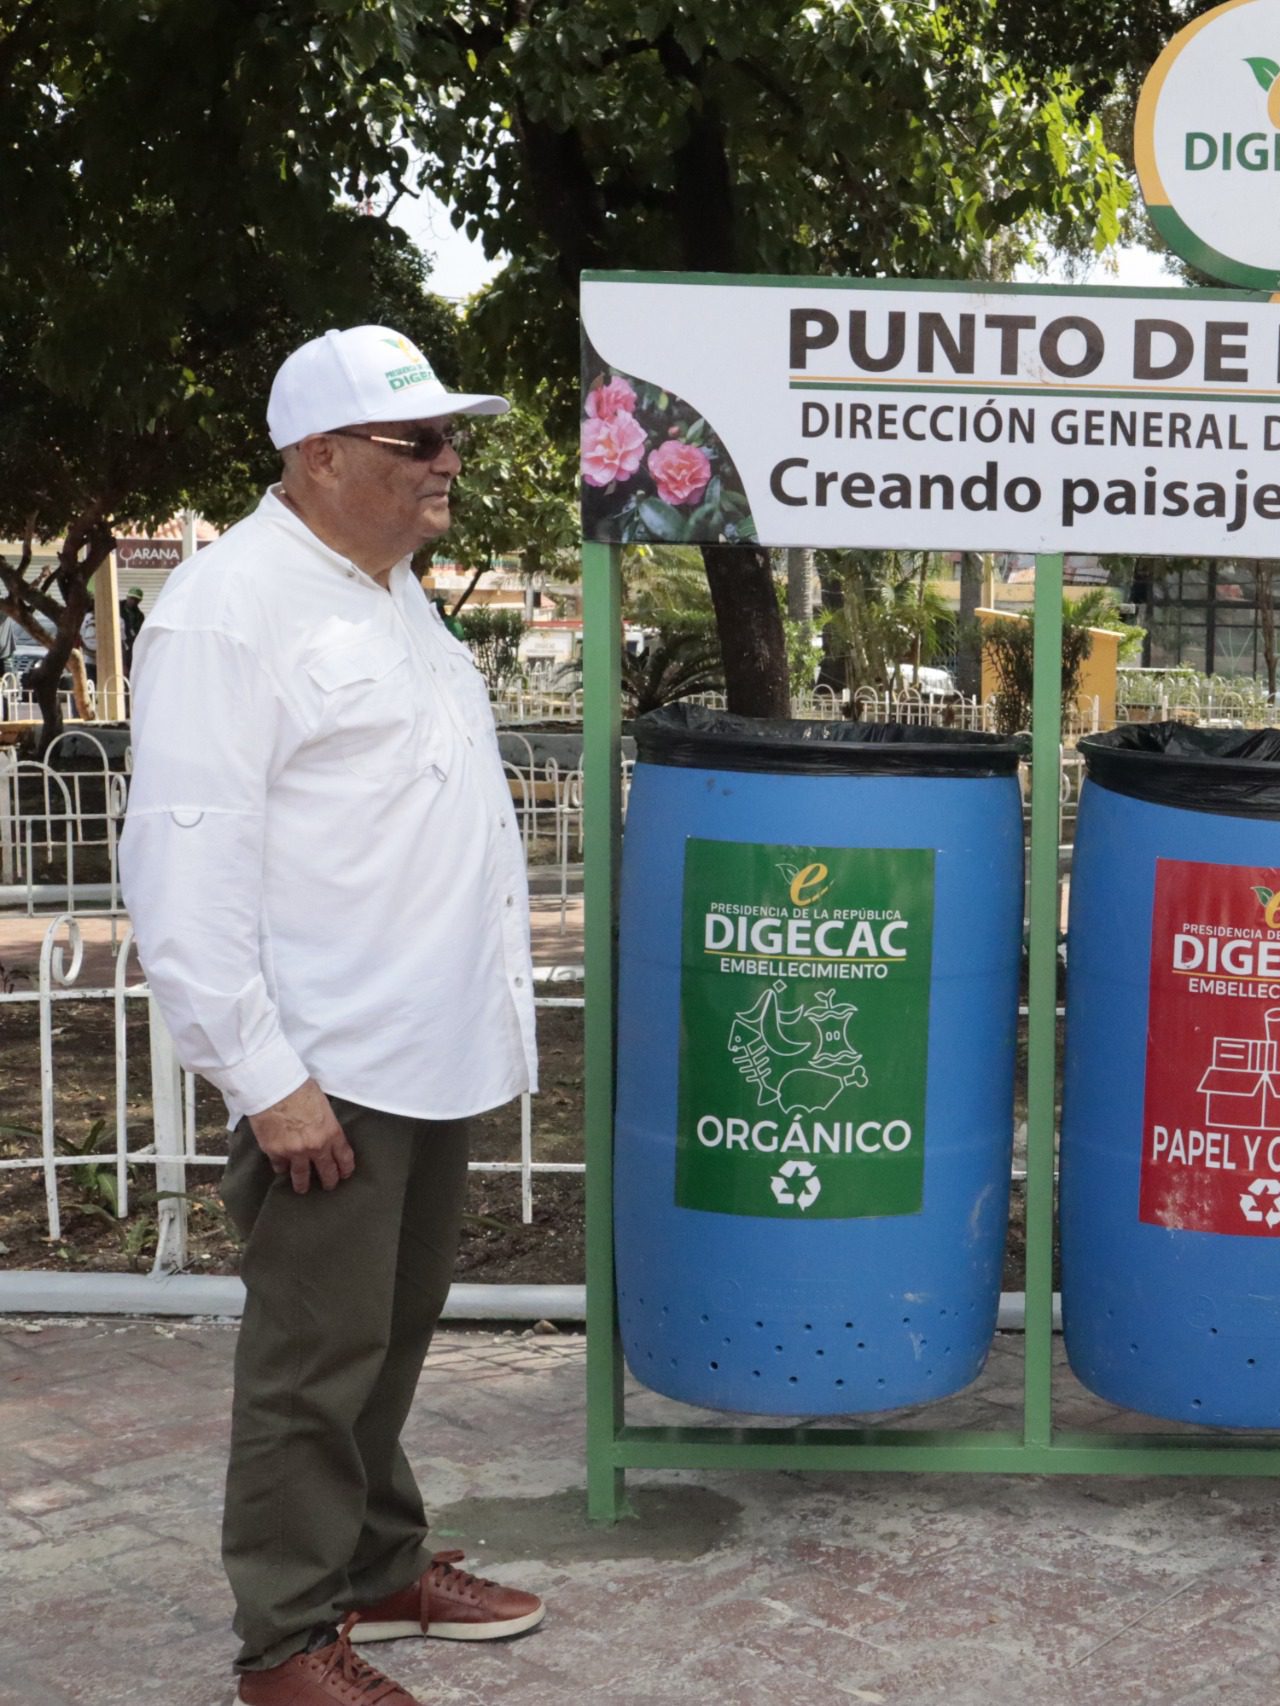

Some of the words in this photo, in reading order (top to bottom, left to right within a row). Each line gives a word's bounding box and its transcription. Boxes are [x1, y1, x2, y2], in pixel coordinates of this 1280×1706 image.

[788, 307, 1105, 378] PUNTO
[1132, 318, 1249, 383] DE
[801, 398, 1036, 444] DIRECCIÓN
[1050, 408, 1249, 451] GENERAL
[770, 457, 1042, 514] Creando
[710, 902, 789, 918] PRESIDENCIA
[792, 908, 809, 919] DE
[813, 908, 829, 920] LA
[833, 907, 901, 920] REPÚBLICA
[1183, 923, 1263, 939] PRESIDENCIA
[704, 913, 909, 957] DIGECAC
[720, 957, 889, 980] EMBELLECIMIENTO
[696, 1113, 912, 1154] ORGÁNICO
[1152, 1125, 1236, 1170] PAPEL
[1243, 1134, 1262, 1172] Y
